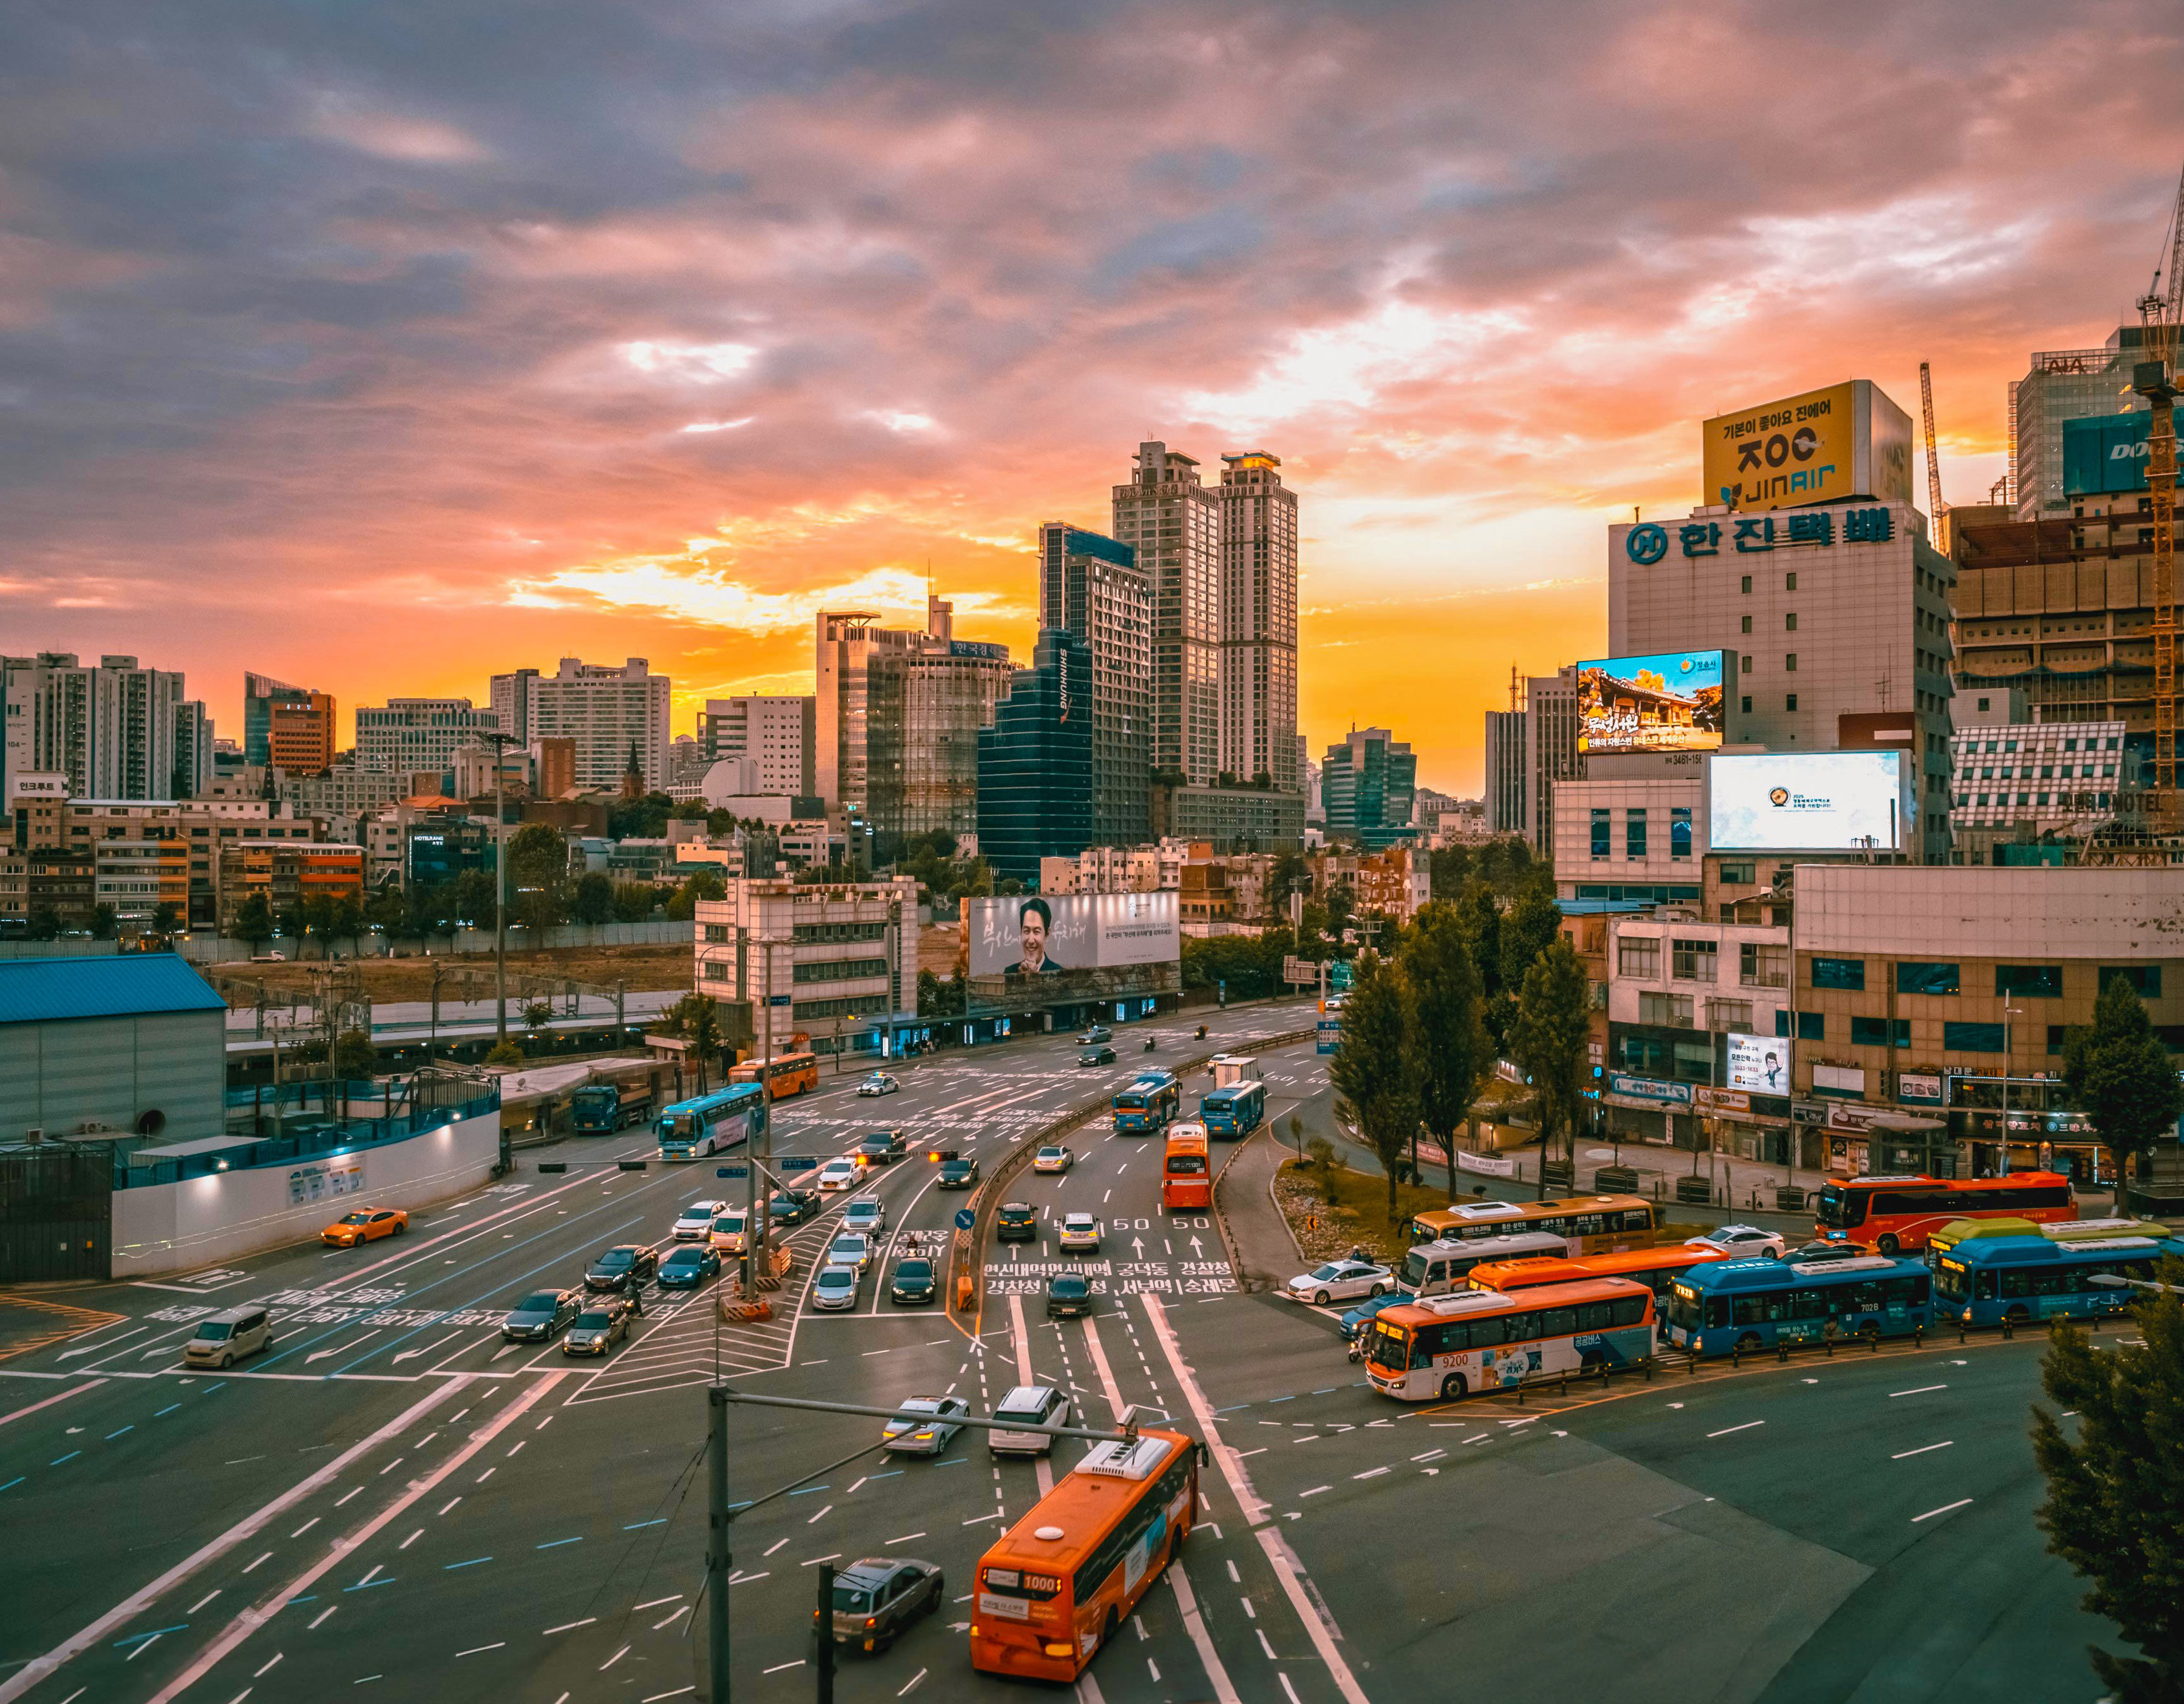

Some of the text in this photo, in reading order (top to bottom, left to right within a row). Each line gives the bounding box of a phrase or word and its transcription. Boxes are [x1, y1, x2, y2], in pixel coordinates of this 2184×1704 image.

[2048, 358, 2084, 374] AIA
[1724, 399, 1831, 439] 기본이 좋아요 진에어
[1679, 507, 1890, 557] 한진택배
[1588, 714, 1639, 734] 무성서원
[1588, 738, 1606, 747] 인류의
[1632, 735, 1659, 745] 유네스코
[20, 782, 54, 791] 인크루트
[1731, 1054, 1750, 1062] 모든인력
[1944, 1066, 1972, 1076] 남대문
[1113, 1218, 1150, 1230] 50
[1172, 1217, 1210, 1230] 50
[984, 1264, 1046, 1277] 연신내역
[1116, 1262, 1168, 1276] 공덕동
[1178, 1261, 1232, 1276] 경찰청
[987, 1279, 1041, 1295] 경찰청
[1121, 1279, 1172, 1294] 서부역
[1184, 1278, 1240, 1293] 숭례문
[1861, 1303, 1879, 1312] 702B
[360, 1310, 449, 1326] 버스전용
[1575, 1333, 1601, 1348] 공공버스
[1443, 1354, 1468, 1369] 9200
[1026, 1576, 1054, 1592] 1000
